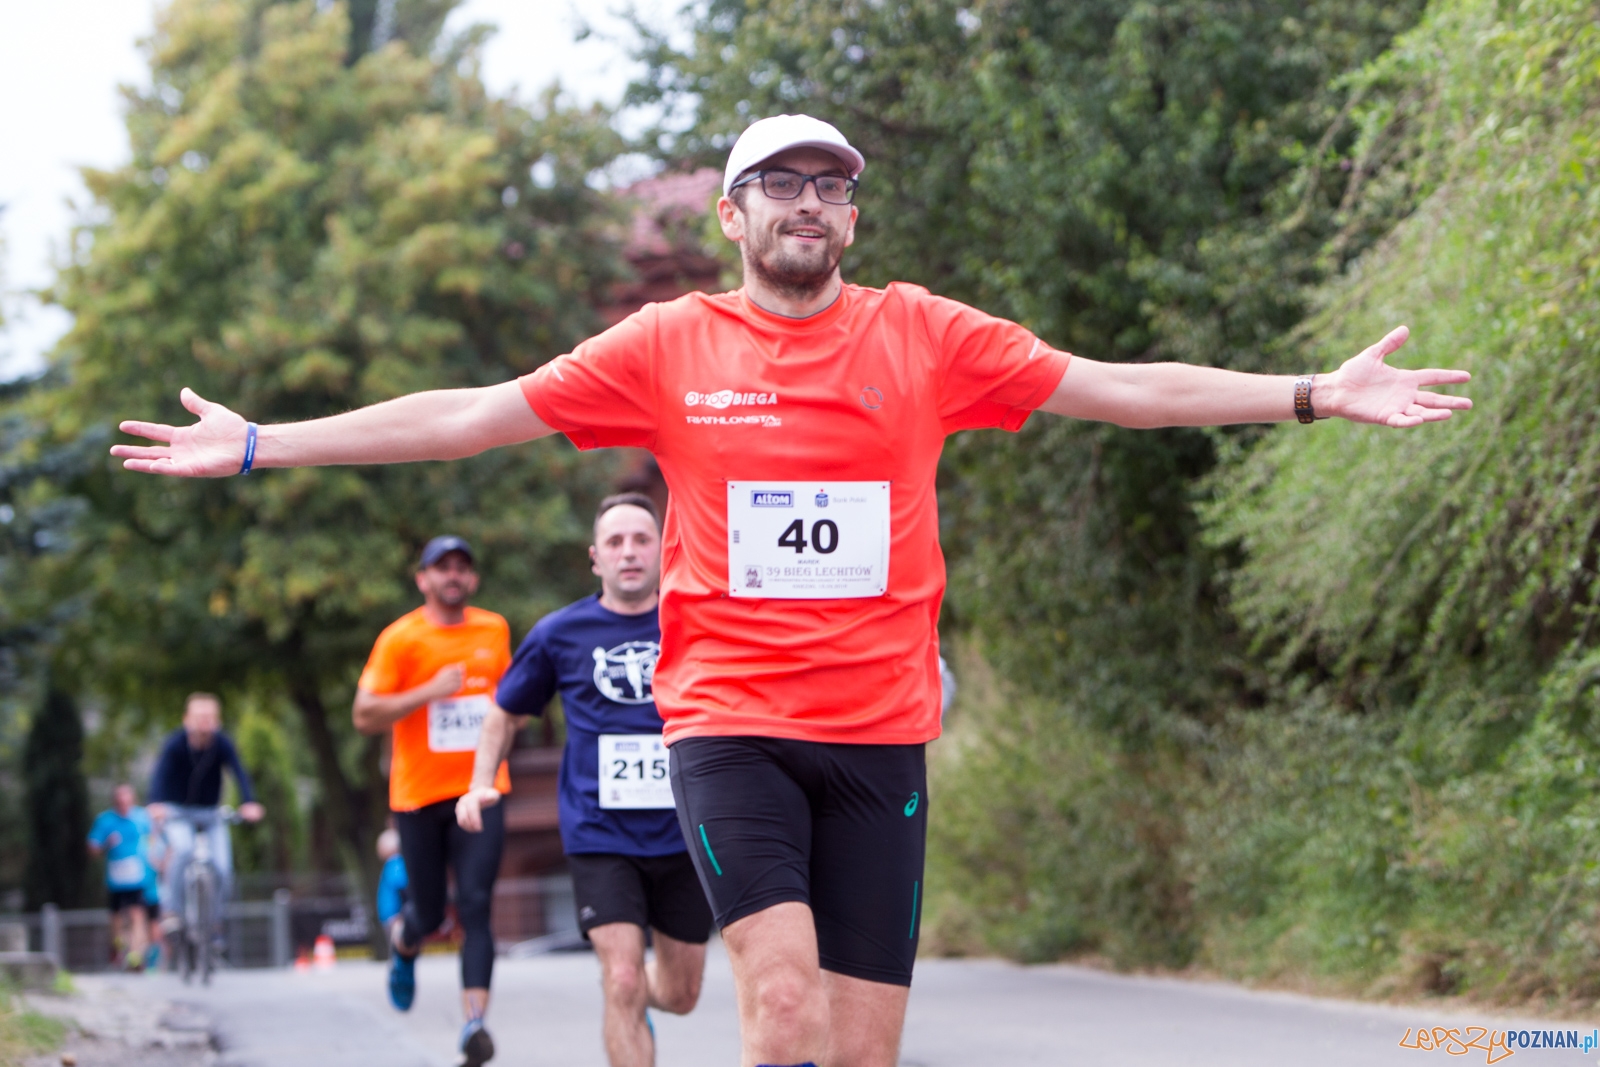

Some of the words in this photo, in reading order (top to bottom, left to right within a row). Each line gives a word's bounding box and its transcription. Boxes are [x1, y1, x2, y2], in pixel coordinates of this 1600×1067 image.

[778, 519, 839, 554] 40
[766, 567, 781, 577] 39
[784, 567, 812, 577] BIEG
[815, 564, 873, 577] LECHITÓW
[613, 759, 667, 780] 215
